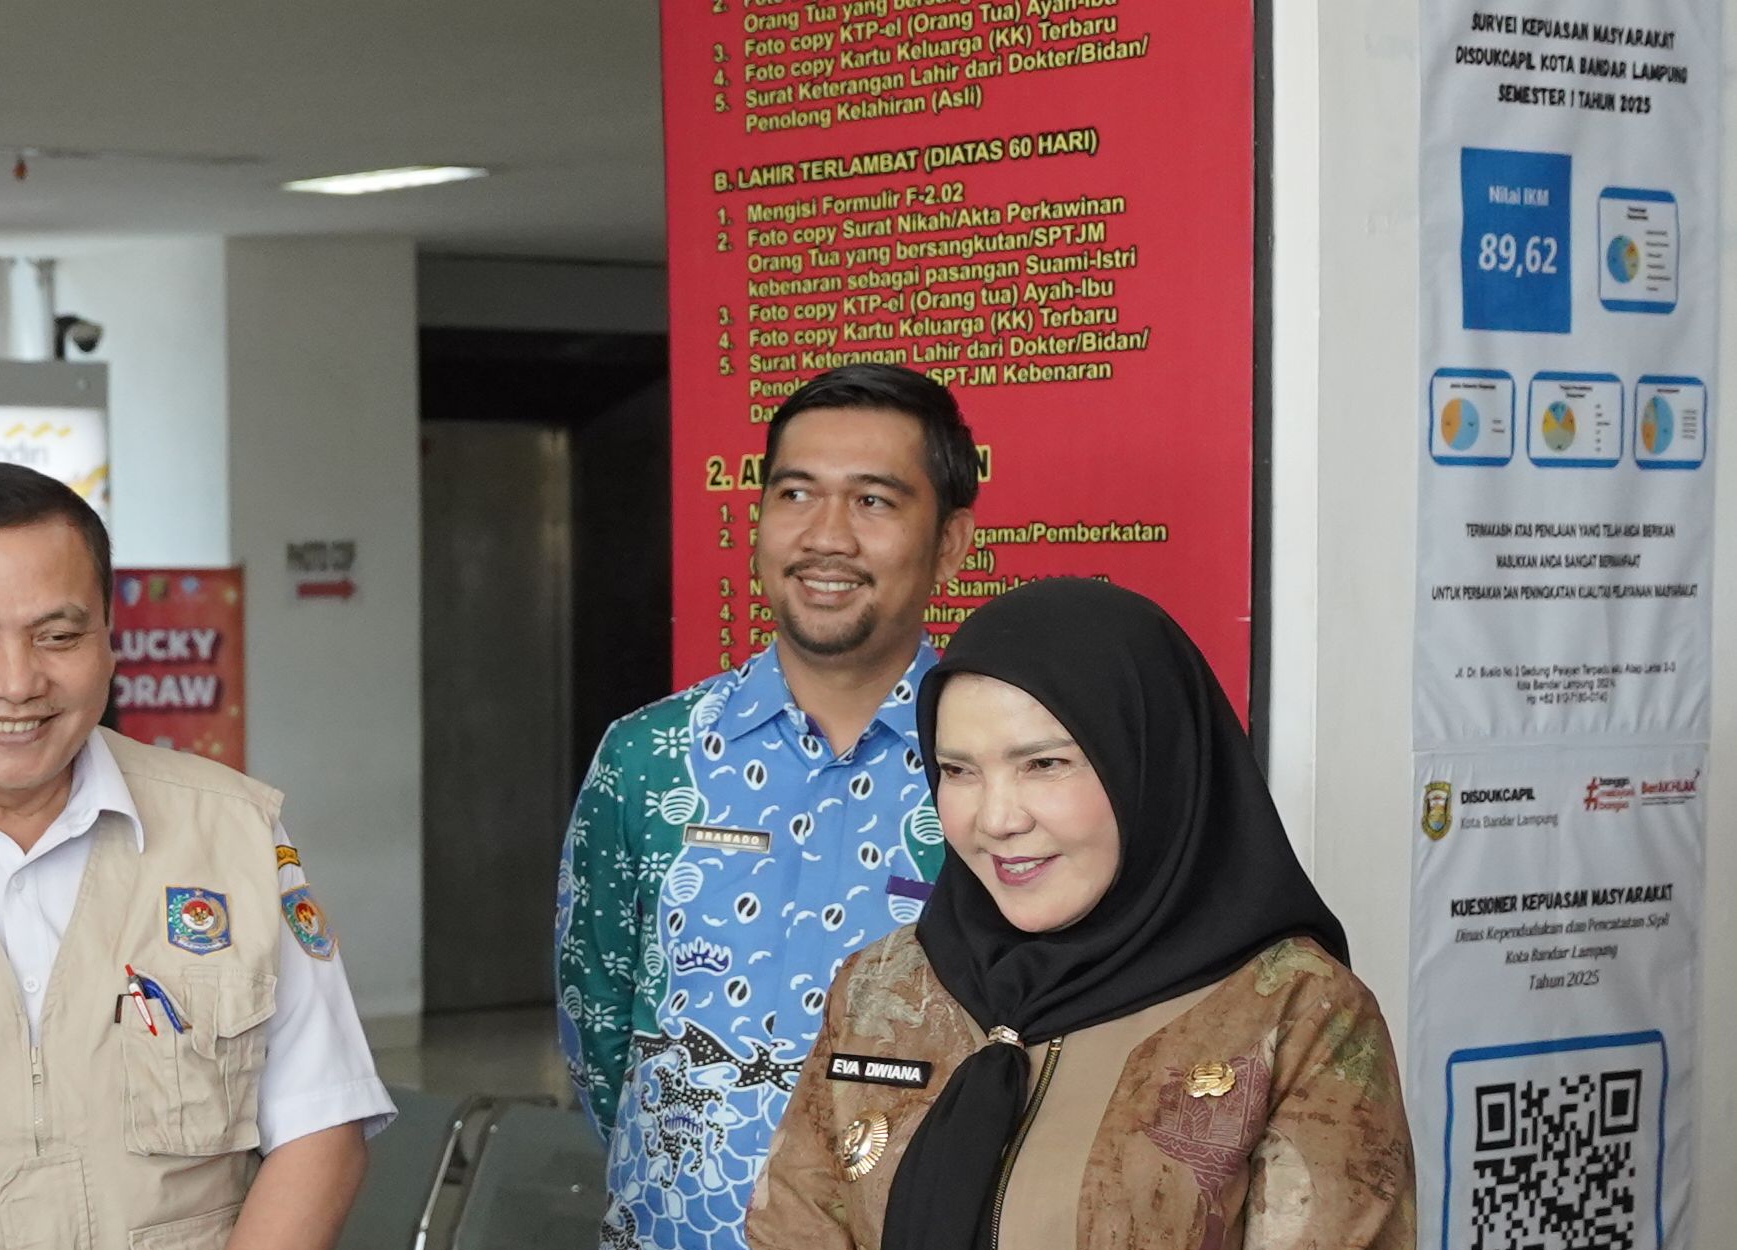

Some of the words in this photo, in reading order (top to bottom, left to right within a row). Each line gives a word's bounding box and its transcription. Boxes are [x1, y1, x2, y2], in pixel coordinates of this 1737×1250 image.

[713, 44, 728, 62] 3.
[744, 38, 786, 58] Foto
[790, 32, 834, 54] copy
[839, 16, 902, 44] KTP-el
[908, 10, 973, 38] (Orang
[979, 2, 1021, 23] Tua)
[744, 11, 799, 32] Orang
[804, 4, 836, 23] Tua
[842, 0, 888, 23] yang
[1472, 12, 1516, 33] SURVEI
[1522, 17, 1589, 40] KEPUASAN
[1594, 22, 1675, 50] MASYARAKAT
[713, 68, 730, 86] 4.
[744, 64, 786, 82] Foto
[790, 57, 835, 78] copy
[840, 48, 890, 70] Kartu
[896, 35, 983, 62] Keluarga
[988, 24, 1032, 52] (KK)
[1038, 15, 1118, 42] Terbaru
[1456, 46, 1536, 70] DISDUKCAPIL
[1540, 53, 1574, 72] KOTA
[1580, 58, 1626, 78] BANDAR
[1632, 62, 1688, 84] LAMPUNG
[714, 93, 730, 112] 5.
[745, 85, 794, 108] Surat
[798, 72, 905, 100] Keterangan
[910, 62, 959, 86] Lahir
[964, 55, 1002, 79] dari
[1008, 32, 1150, 74] Dokter/Bidan/
[745, 108, 832, 133] Penolong
[836, 95, 926, 121] Kelahiran
[932, 84, 982, 114] (Asli)
[1498, 84, 1565, 106] SEMESTER
[1578, 92, 1615, 111] TAHUN
[1621, 96, 1651, 114] 2025
[714, 172, 734, 192] B.
[738, 162, 796, 190] LAHIR
[800, 148, 919, 181] TERLAMBAT
[924, 140, 1004, 172] (DIATAS
[1008, 136, 1032, 158] 60
[1038, 128, 1098, 156] HARI)
[718, 208, 732, 226] 1.
[747, 196, 817, 224] Mengisi
[822, 190, 900, 216] Formulir
[905, 182, 964, 206] F-2.02
[1489, 185, 1520, 204] Nilai
[717, 232, 732, 251] 2.
[747, 228, 788, 248] Foto
[793, 224, 836, 244] copy
[842, 216, 892, 240] Surat
[898, 207, 1000, 233] Nikah/Akta
[1006, 194, 1126, 224] Perkawinan
[748, 254, 802, 274] Orang
[808, 248, 840, 267] Tua
[846, 246, 890, 268] yang
[896, 222, 1105, 260] bersangkutan/SPTJM
[1478, 232, 1558, 278] 89,62
[748, 278, 842, 297] kebenaran
[848, 266, 919, 292] sebagai
[925, 260, 1019, 287] pasangan
[1026, 245, 1136, 276] Suami-Istri
[718, 307, 734, 325] 3.
[748, 304, 789, 322] Foto
[794, 302, 837, 321] copy
[843, 294, 904, 314] KTP-el
[910, 289, 975, 316] (Orang
[981, 284, 1018, 306] tua)
[1024, 278, 1114, 306] Ayah-Ibu
[718, 332, 734, 350] 4.
[748, 329, 789, 347] Foto
[794, 327, 838, 346] copy
[843, 322, 894, 341] Kartu
[900, 314, 984, 337] Keluarga
[990, 310, 1033, 336] (KK)
[1040, 305, 1117, 329] Terbaru
[719, 356, 734, 375] 5.
[750, 354, 796, 374] Surat
[802, 347, 906, 370] Keterangan
[913, 343, 960, 363] Lahir
[967, 339, 1003, 359] dari
[1010, 326, 1150, 357] Dokter/Bidan/
[1003, 362, 1112, 384] Kebenaran
[706, 456, 733, 490] 2.
[720, 504, 734, 522] 1.
[719, 529, 734, 547] 2.
[974, 520, 1167, 548] gama/Pemberkatan
[720, 578, 734, 597] 3.
[720, 604, 734, 621] 4.
[720, 628, 734, 646] 5.
[1461, 787, 1535, 804] DISDUKCAPIL
[696, 830, 760, 845] BRAMADO
[1460, 816, 1481, 829] Kota
[1483, 814, 1514, 828] Bandar
[1518, 812, 1558, 828] Lampung
[1451, 898, 1517, 918] KUESIONER
[1522, 892, 1588, 912] KEPUASAN
[1592, 884, 1673, 908] MASYARAKAT
[1456, 928, 1484, 943] Dinas
[1566, 920, 1586, 933] dan
[1505, 950, 1528, 964] Kota
[1531, 948, 1570, 962] Bandar
[1572, 944, 1618, 960] Lampung
[1529, 975, 1564, 990] Tahun
[1566, 970, 1600, 988] 2025
[832, 1058, 860, 1075] EVA
[864, 1062, 922, 1082] DWIANA
